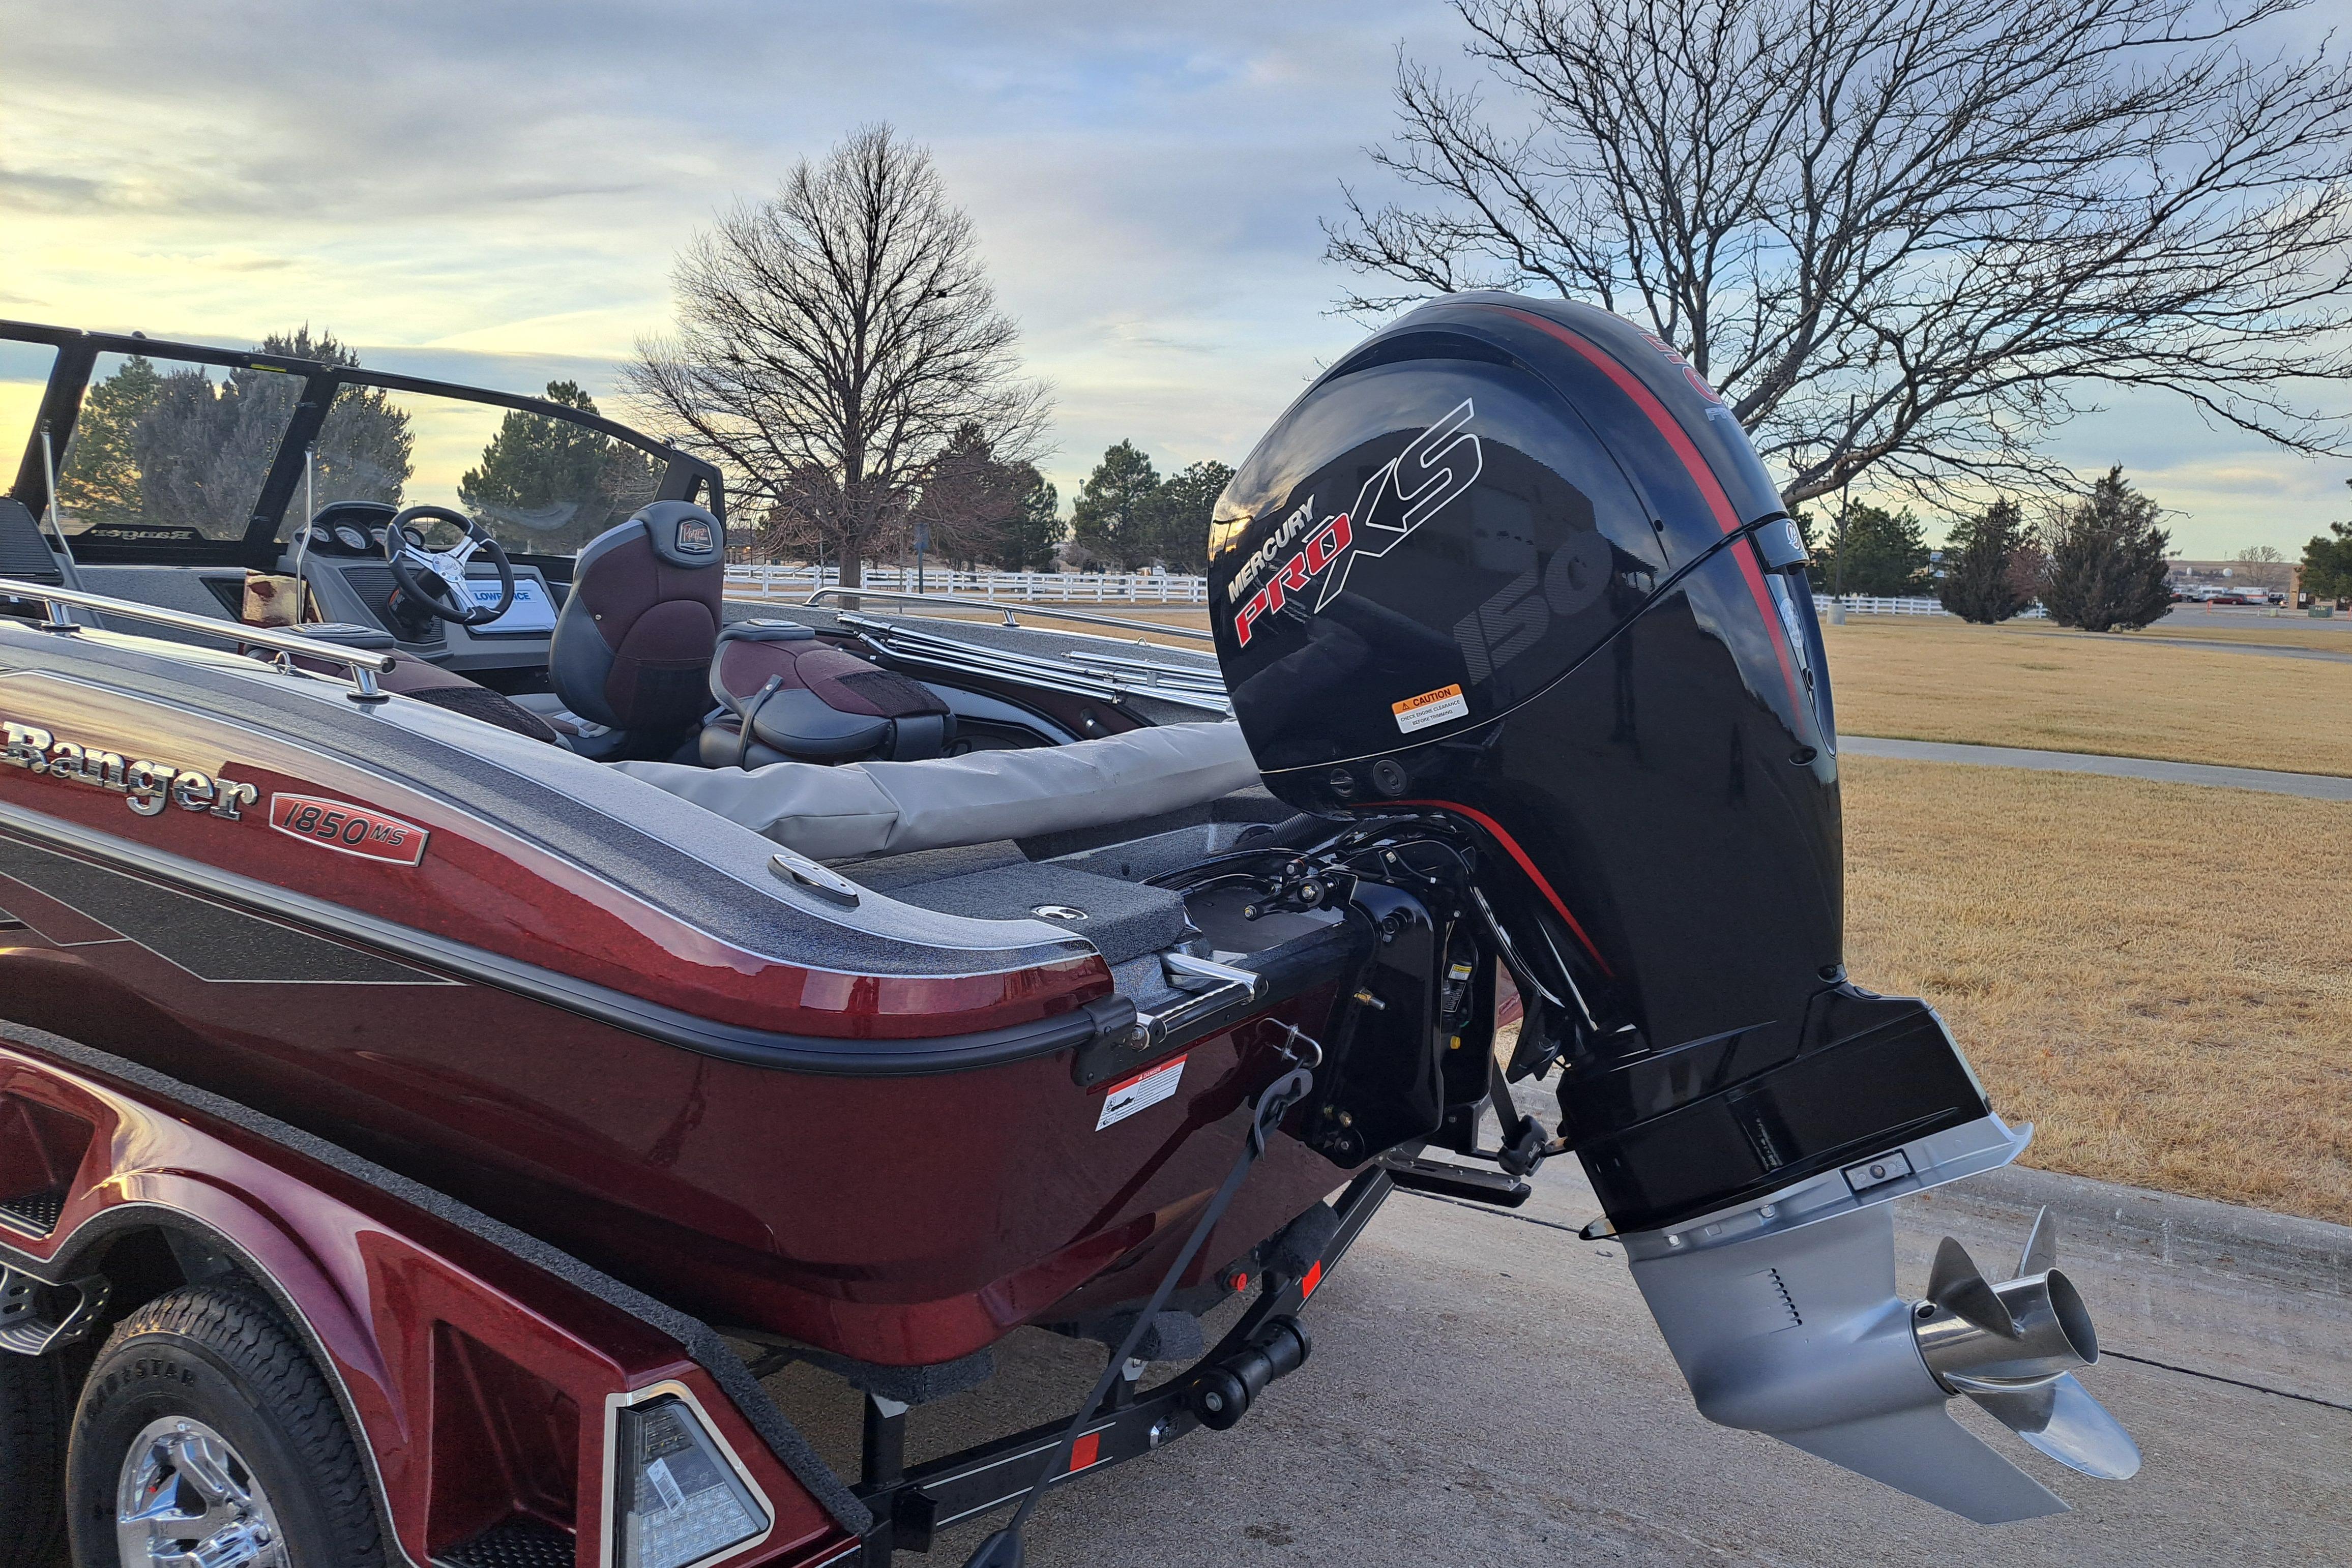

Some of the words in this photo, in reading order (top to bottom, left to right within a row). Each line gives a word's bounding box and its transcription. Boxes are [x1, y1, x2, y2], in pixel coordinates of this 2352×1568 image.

[1227, 493, 1315, 604] MERCURY
[1453, 531, 1613, 687] 150
[1400, 714, 1416, 722] CHECK
[1416, 708, 1433, 717] ENGINE
[1433, 699, 1461, 713] CLEARANCE
[1412, 717, 1430, 725] BEFORE
[1430, 709, 1453, 720] TRIMMING
[1413, 688, 1451, 706] CAUTION
[0, 721, 258, 821] Ranger
[282, 801, 370, 846] 1850
[369, 823, 409, 846] MS
